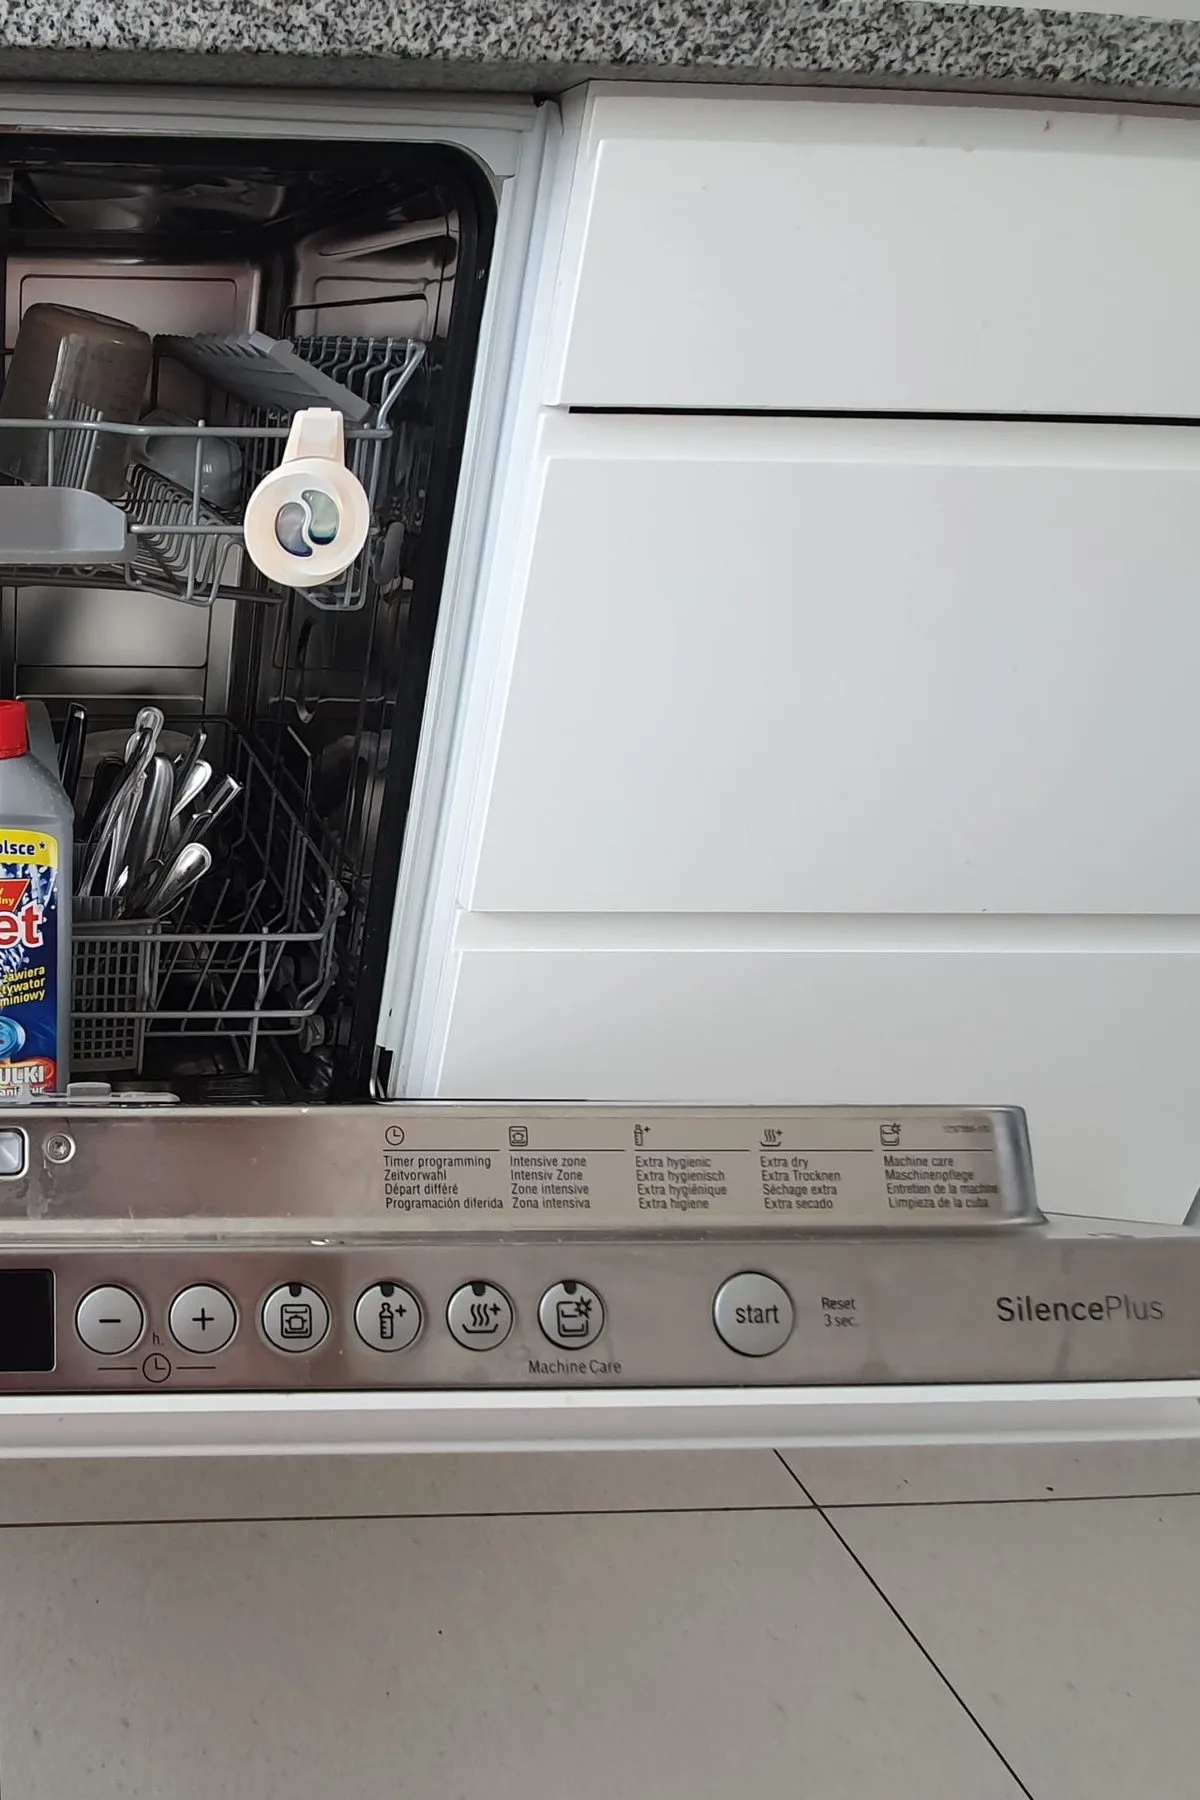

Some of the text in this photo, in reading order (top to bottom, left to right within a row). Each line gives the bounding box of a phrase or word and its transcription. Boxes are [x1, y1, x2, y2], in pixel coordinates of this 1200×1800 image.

[3, 966, 46, 983] zawiera
[384, 1156, 491, 1170] Timer programming
[510, 1156, 587, 1167] Intensive zone
[635, 1156, 711, 1170] Extra hygienic
[760, 1156, 809, 1169] Extra dry
[884, 1155, 954, 1167] Machine care
[384, 1170, 447, 1181] Zeitvorwahl
[510, 1169, 583, 1181] Intensiv Zone
[636, 1170, 725, 1184] Extra hygienisch
[761, 1170, 841, 1182] Extra Trocknen
[885, 1169, 974, 1182] Maschinenpflege
[385, 1183, 458, 1197] Départ différé
[511, 1183, 589, 1195] Zone intensive
[637, 1183, 727, 1198] Extra hygiénique
[763, 1183, 838, 1198] Séchage extra
[887, 1183, 999, 1195] Entretien de la machine
[385, 1197, 504, 1211] Programación diferida
[512, 1197, 591, 1209] Zona intensiva
[639, 1198, 667, 1210] Extra
[764, 1198, 833, 1210] Extra secado
[888, 1197, 936, 1209] Limpieza
[938, 1197, 951, 1208] de
[953, 1197, 963, 1208] la
[821, 1297, 857, 1310] Reset
[996, 1294, 1165, 1322] SilencePlus
[735, 1304, 780, 1324] start
[824, 1314, 833, 1327] 3
[528, 1360, 622, 1375] Machine Care
